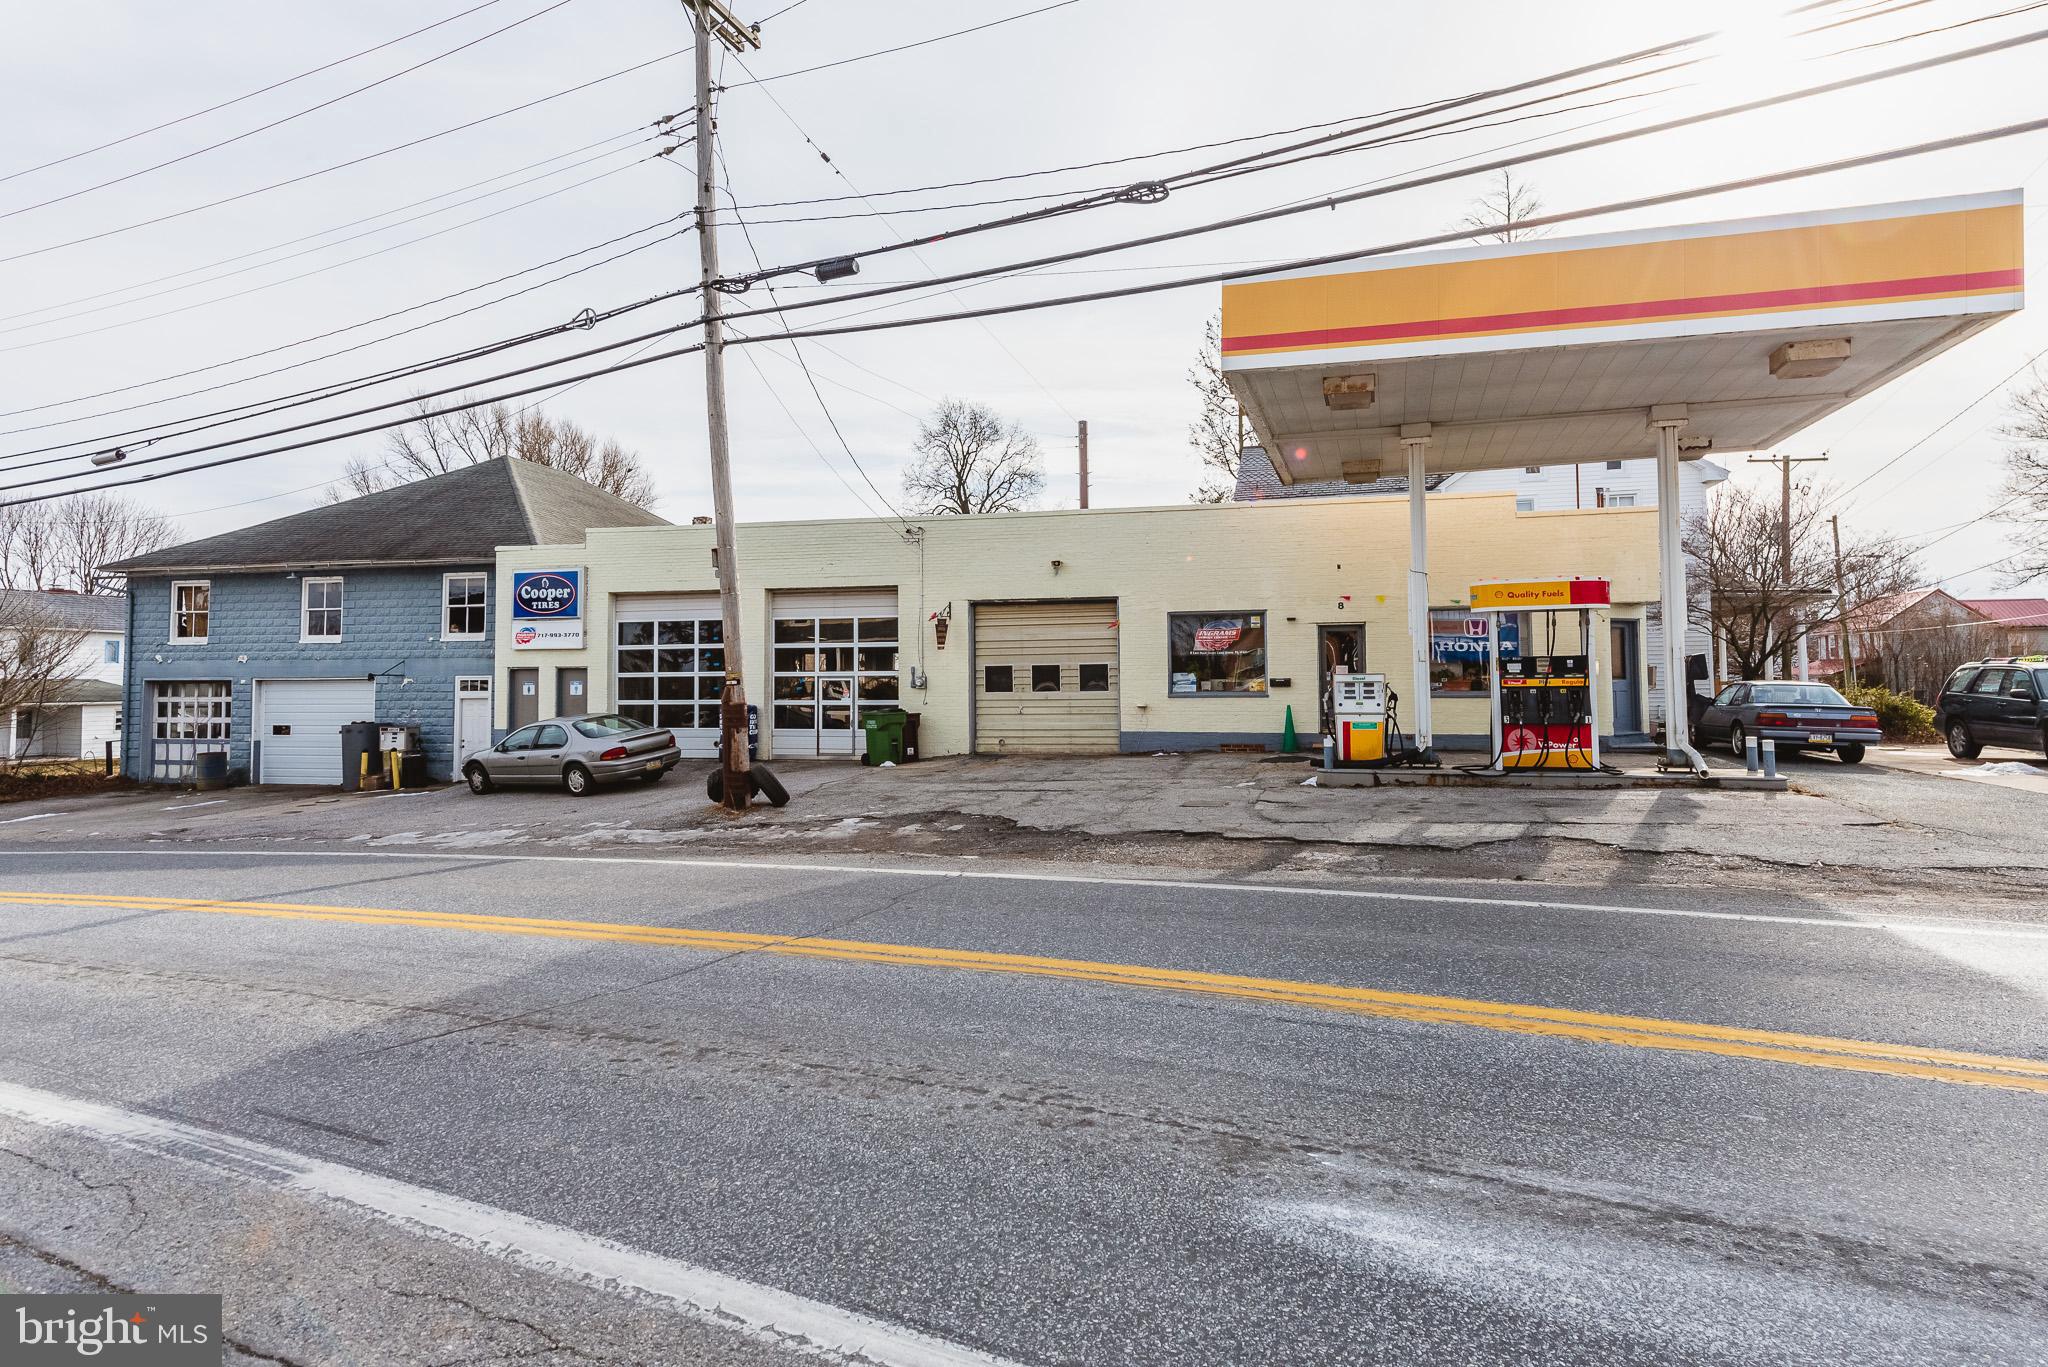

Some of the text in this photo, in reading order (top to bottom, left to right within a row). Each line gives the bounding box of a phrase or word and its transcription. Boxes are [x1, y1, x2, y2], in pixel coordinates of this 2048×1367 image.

[521, 586, 571, 601] Cooper
[1507, 590, 1564, 599] Quality Fuels
[1538, 740, 1577, 749] V-Power
